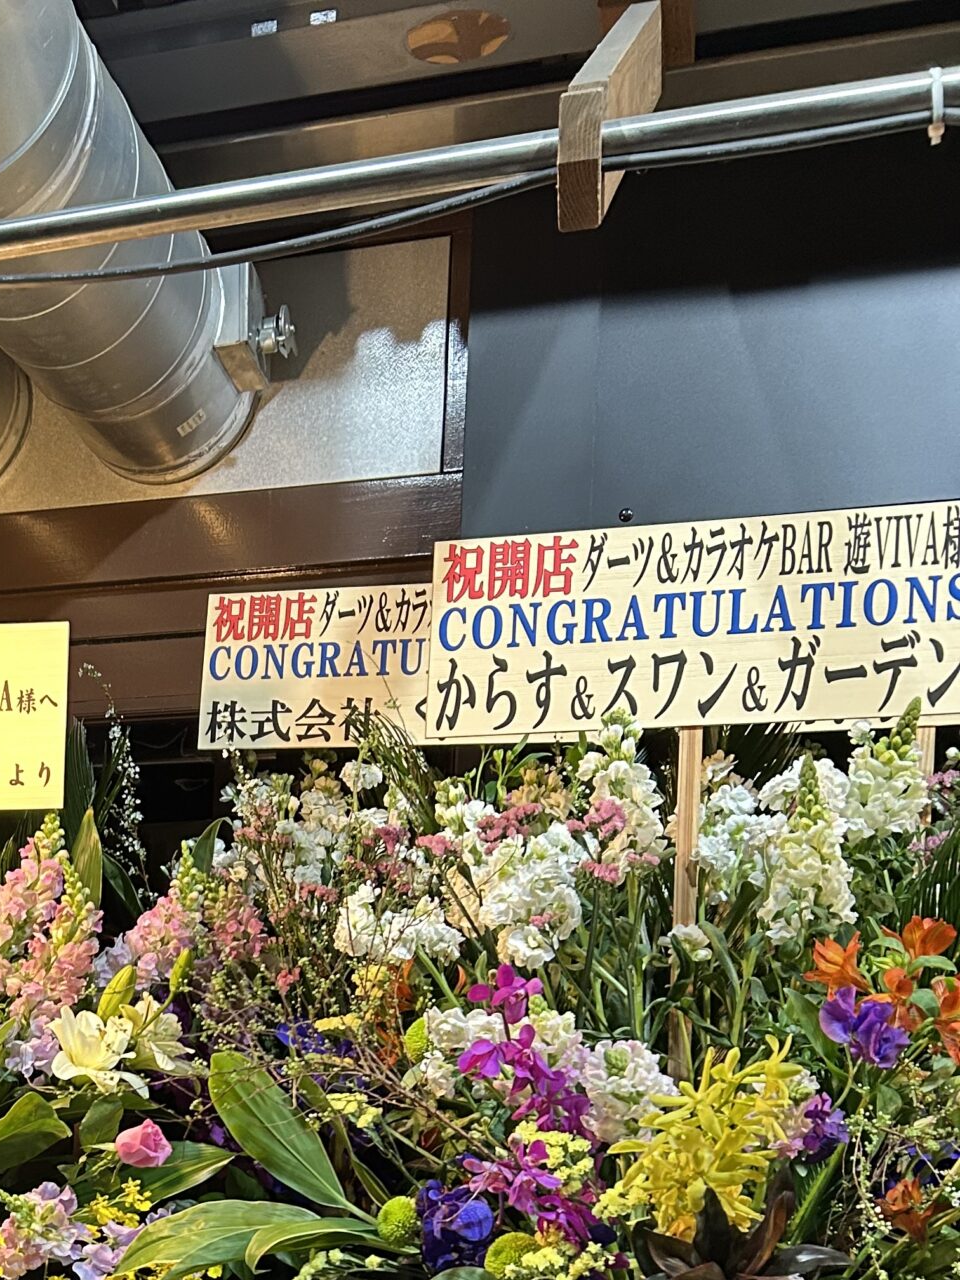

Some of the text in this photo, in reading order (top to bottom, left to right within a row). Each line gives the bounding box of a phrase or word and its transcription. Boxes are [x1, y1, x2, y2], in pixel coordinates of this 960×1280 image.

[441, 535, 579, 602] 祝開店
[583, 520, 833, 592] ダーツ&カラオケBAR
[212, 588, 433, 642] 祝開店 ダーツ&カラ
[438, 573, 960, 652] CONGRATULATIONS
[209, 637, 431, 681] CONGRATU
[205, 697, 380, 743] 株式会社
